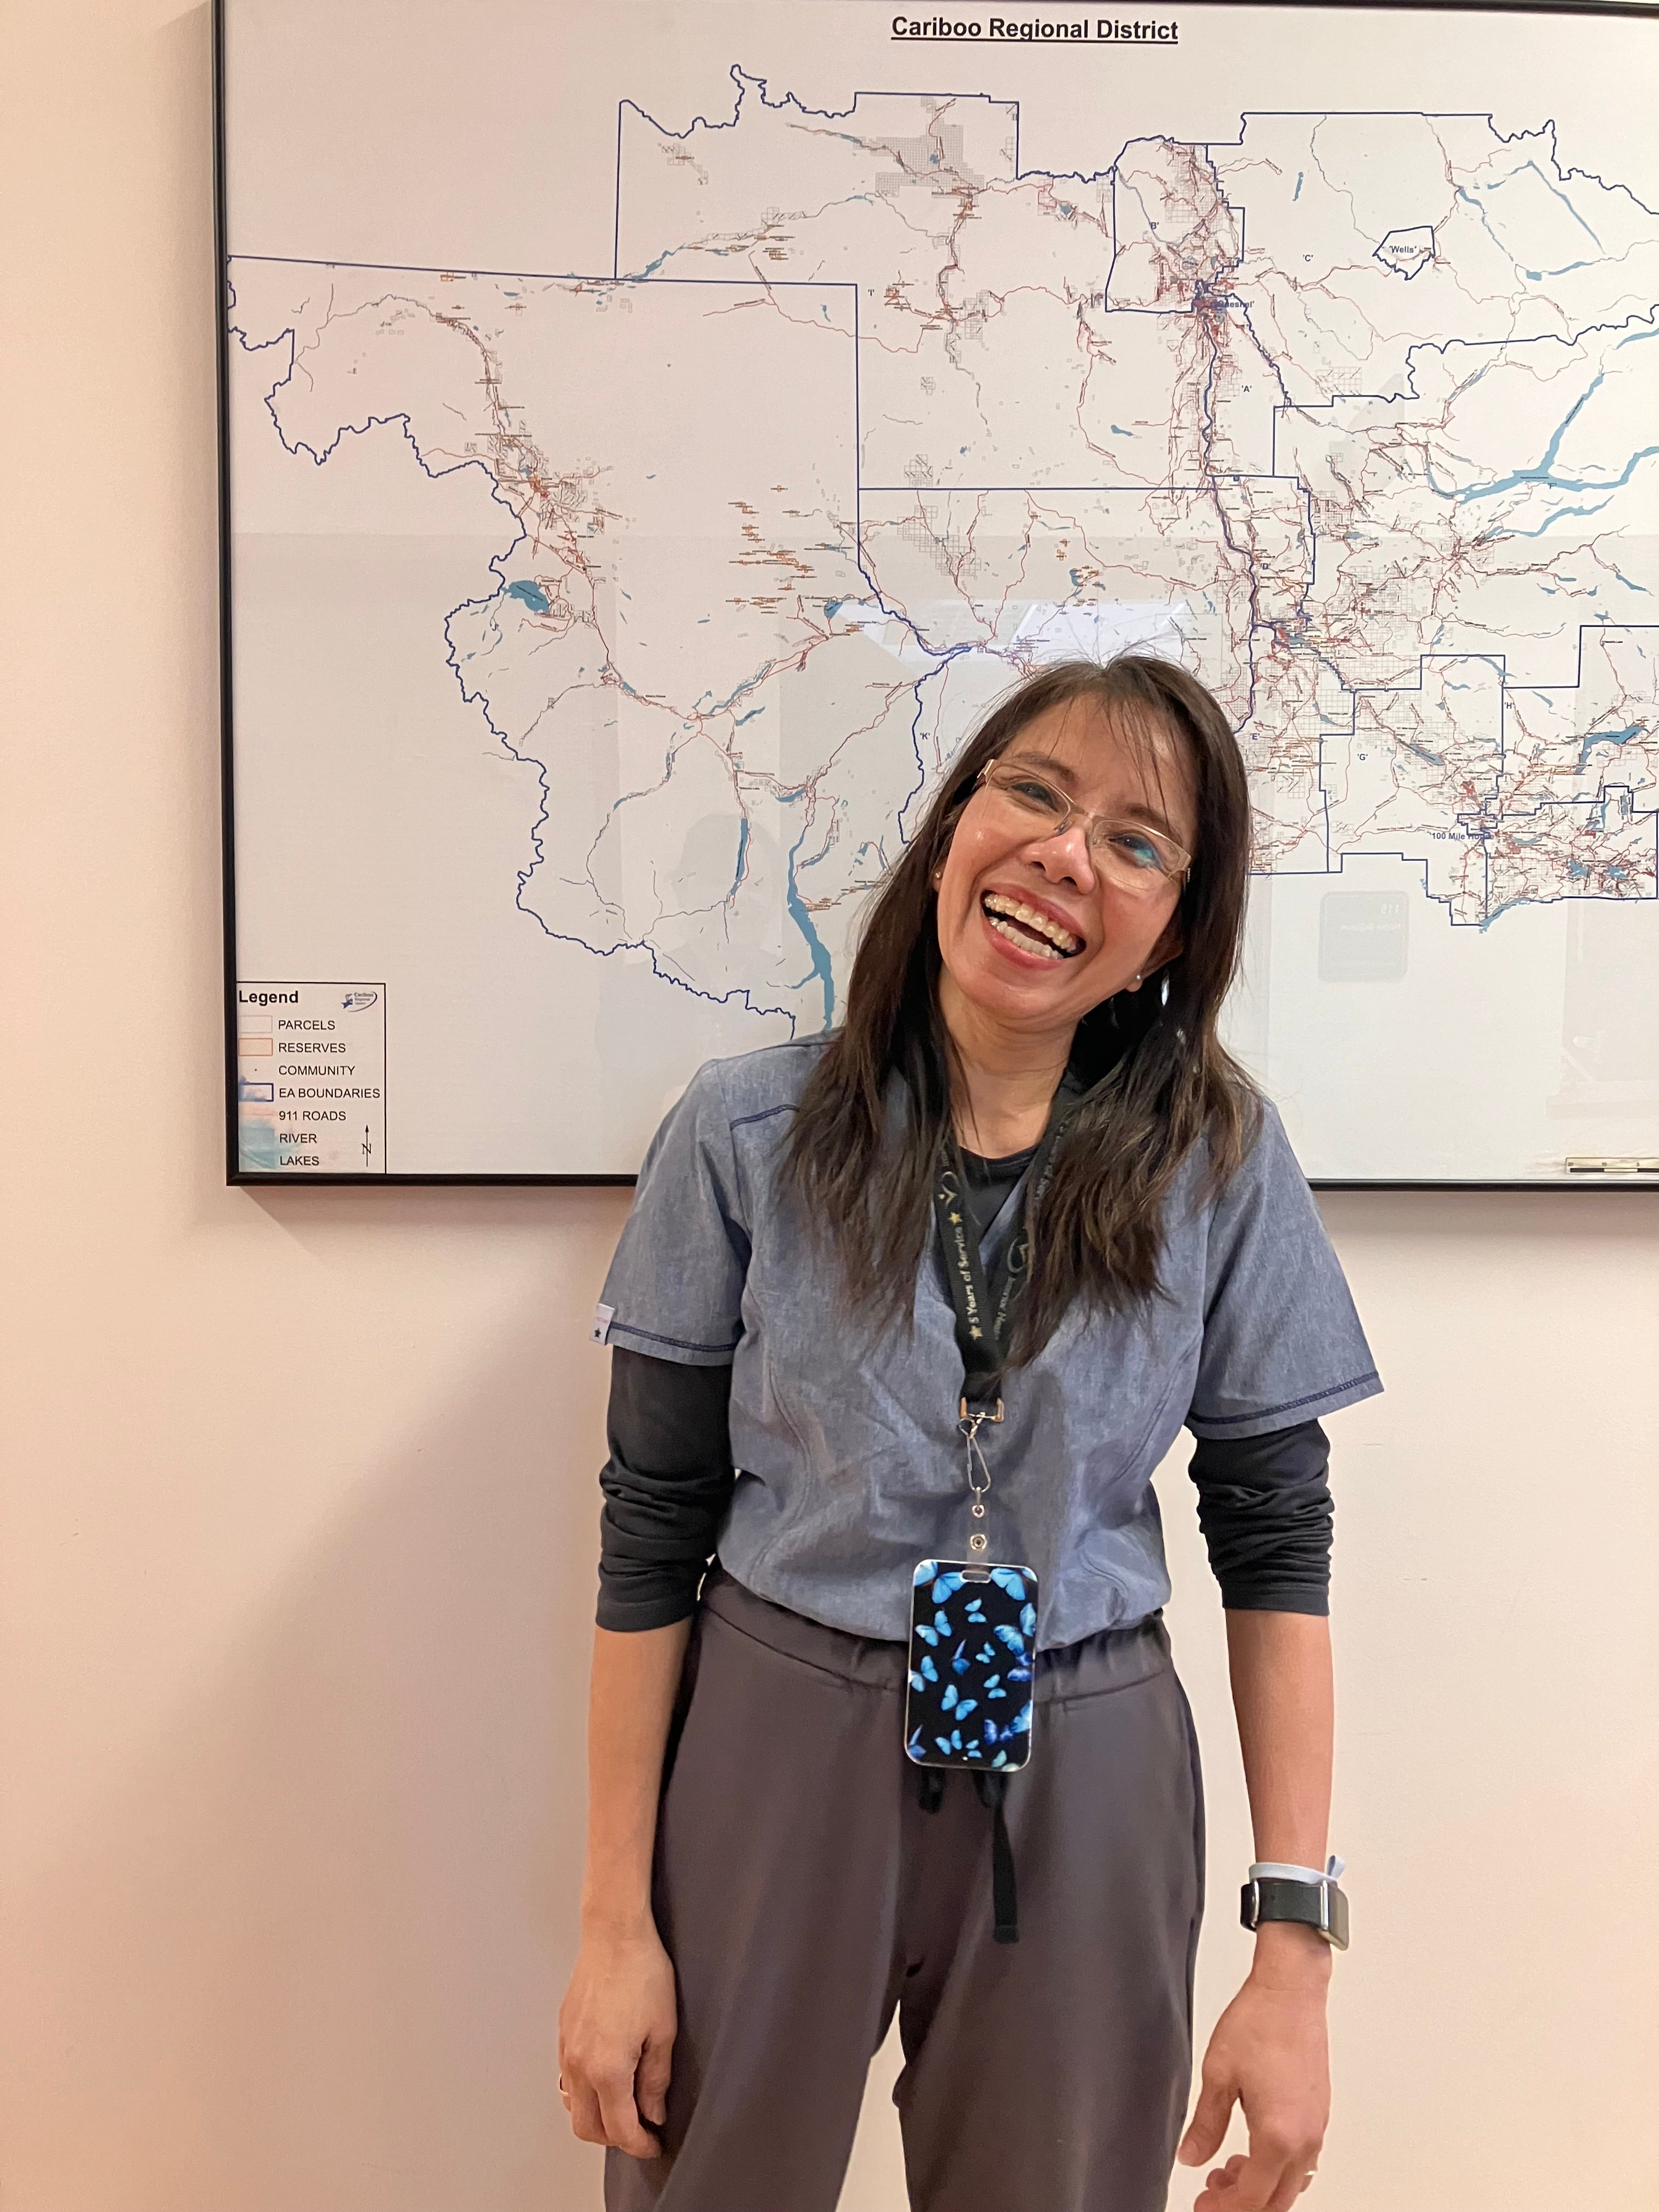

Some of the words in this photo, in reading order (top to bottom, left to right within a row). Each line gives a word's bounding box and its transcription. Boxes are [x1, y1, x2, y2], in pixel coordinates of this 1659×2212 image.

[892, 16, 981, 36] Cariboo
[989, 18, 1088, 40] Regional
[1097, 20, 1178, 40] District
[239, 990, 298, 1006] Legend
[278, 1020, 335, 1030] PARCELS
[279, 1043, 346, 1053] RESERVES
[279, 1065, 356, 1075] COMMUNITY
[279, 1088, 295, 1098] EA
[298, 1088, 381, 1098] BOUNDARIES
[279, 1111, 298, 1120] 911
[303, 1111, 346, 1121] ROADS
[279, 1133, 317, 1143] RIVER
[280, 1156, 319, 1166] LAKES
